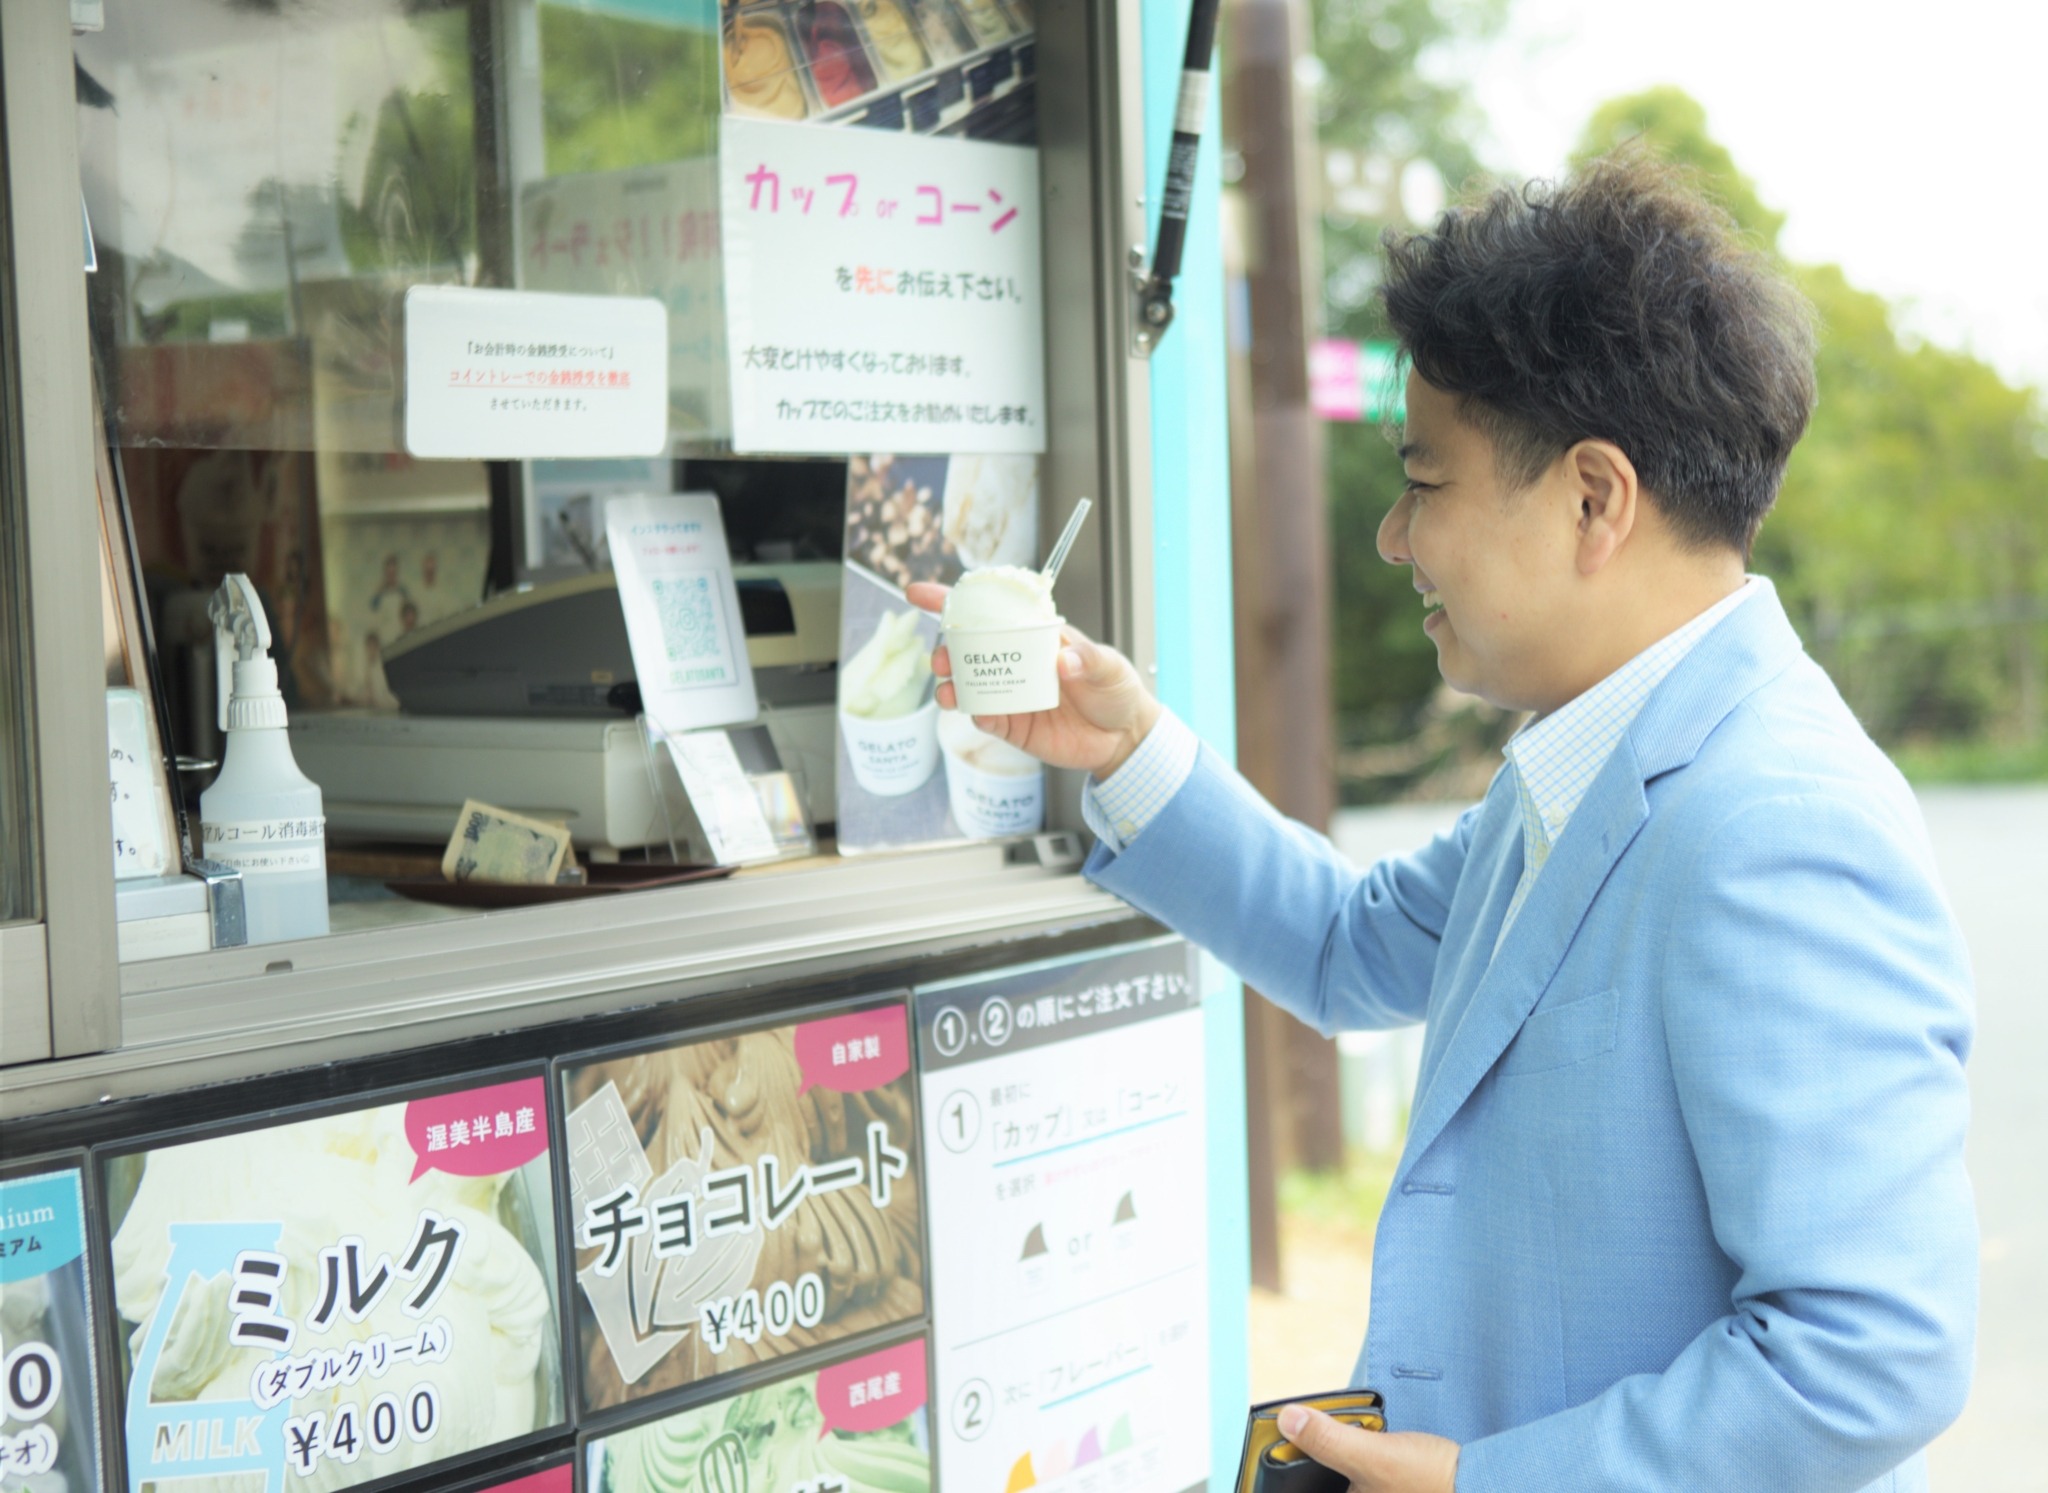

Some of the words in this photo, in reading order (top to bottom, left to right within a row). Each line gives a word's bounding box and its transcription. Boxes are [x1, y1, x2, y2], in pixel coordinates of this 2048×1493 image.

[745, 163, 859, 218] カップ
[876, 199, 898, 219] or
[915, 184, 1018, 234] コーン
[836, 265, 1022, 303] を先にお伝え下さい。
[743, 345, 972, 378] 大変とけやすくなっております。
[963, 651, 1022, 665] GELATO
[973, 666, 1013, 677] SANTA
[858, 737, 917, 753] GELATO
[831, 1034, 881, 1067] 自家製
[425, 1106, 536, 1153] 渥美半島産
[0, 1206, 55, 1230] ium
[589, 1130, 902, 1269] チョコレート
[235, 1217, 460, 1344] ミルク
[704, 1279, 822, 1346] ¥400
[848, 1372, 902, 1408] 西尾産
[151, 1415, 265, 1464] MILK
[289, 1389, 436, 1469] ¥400
